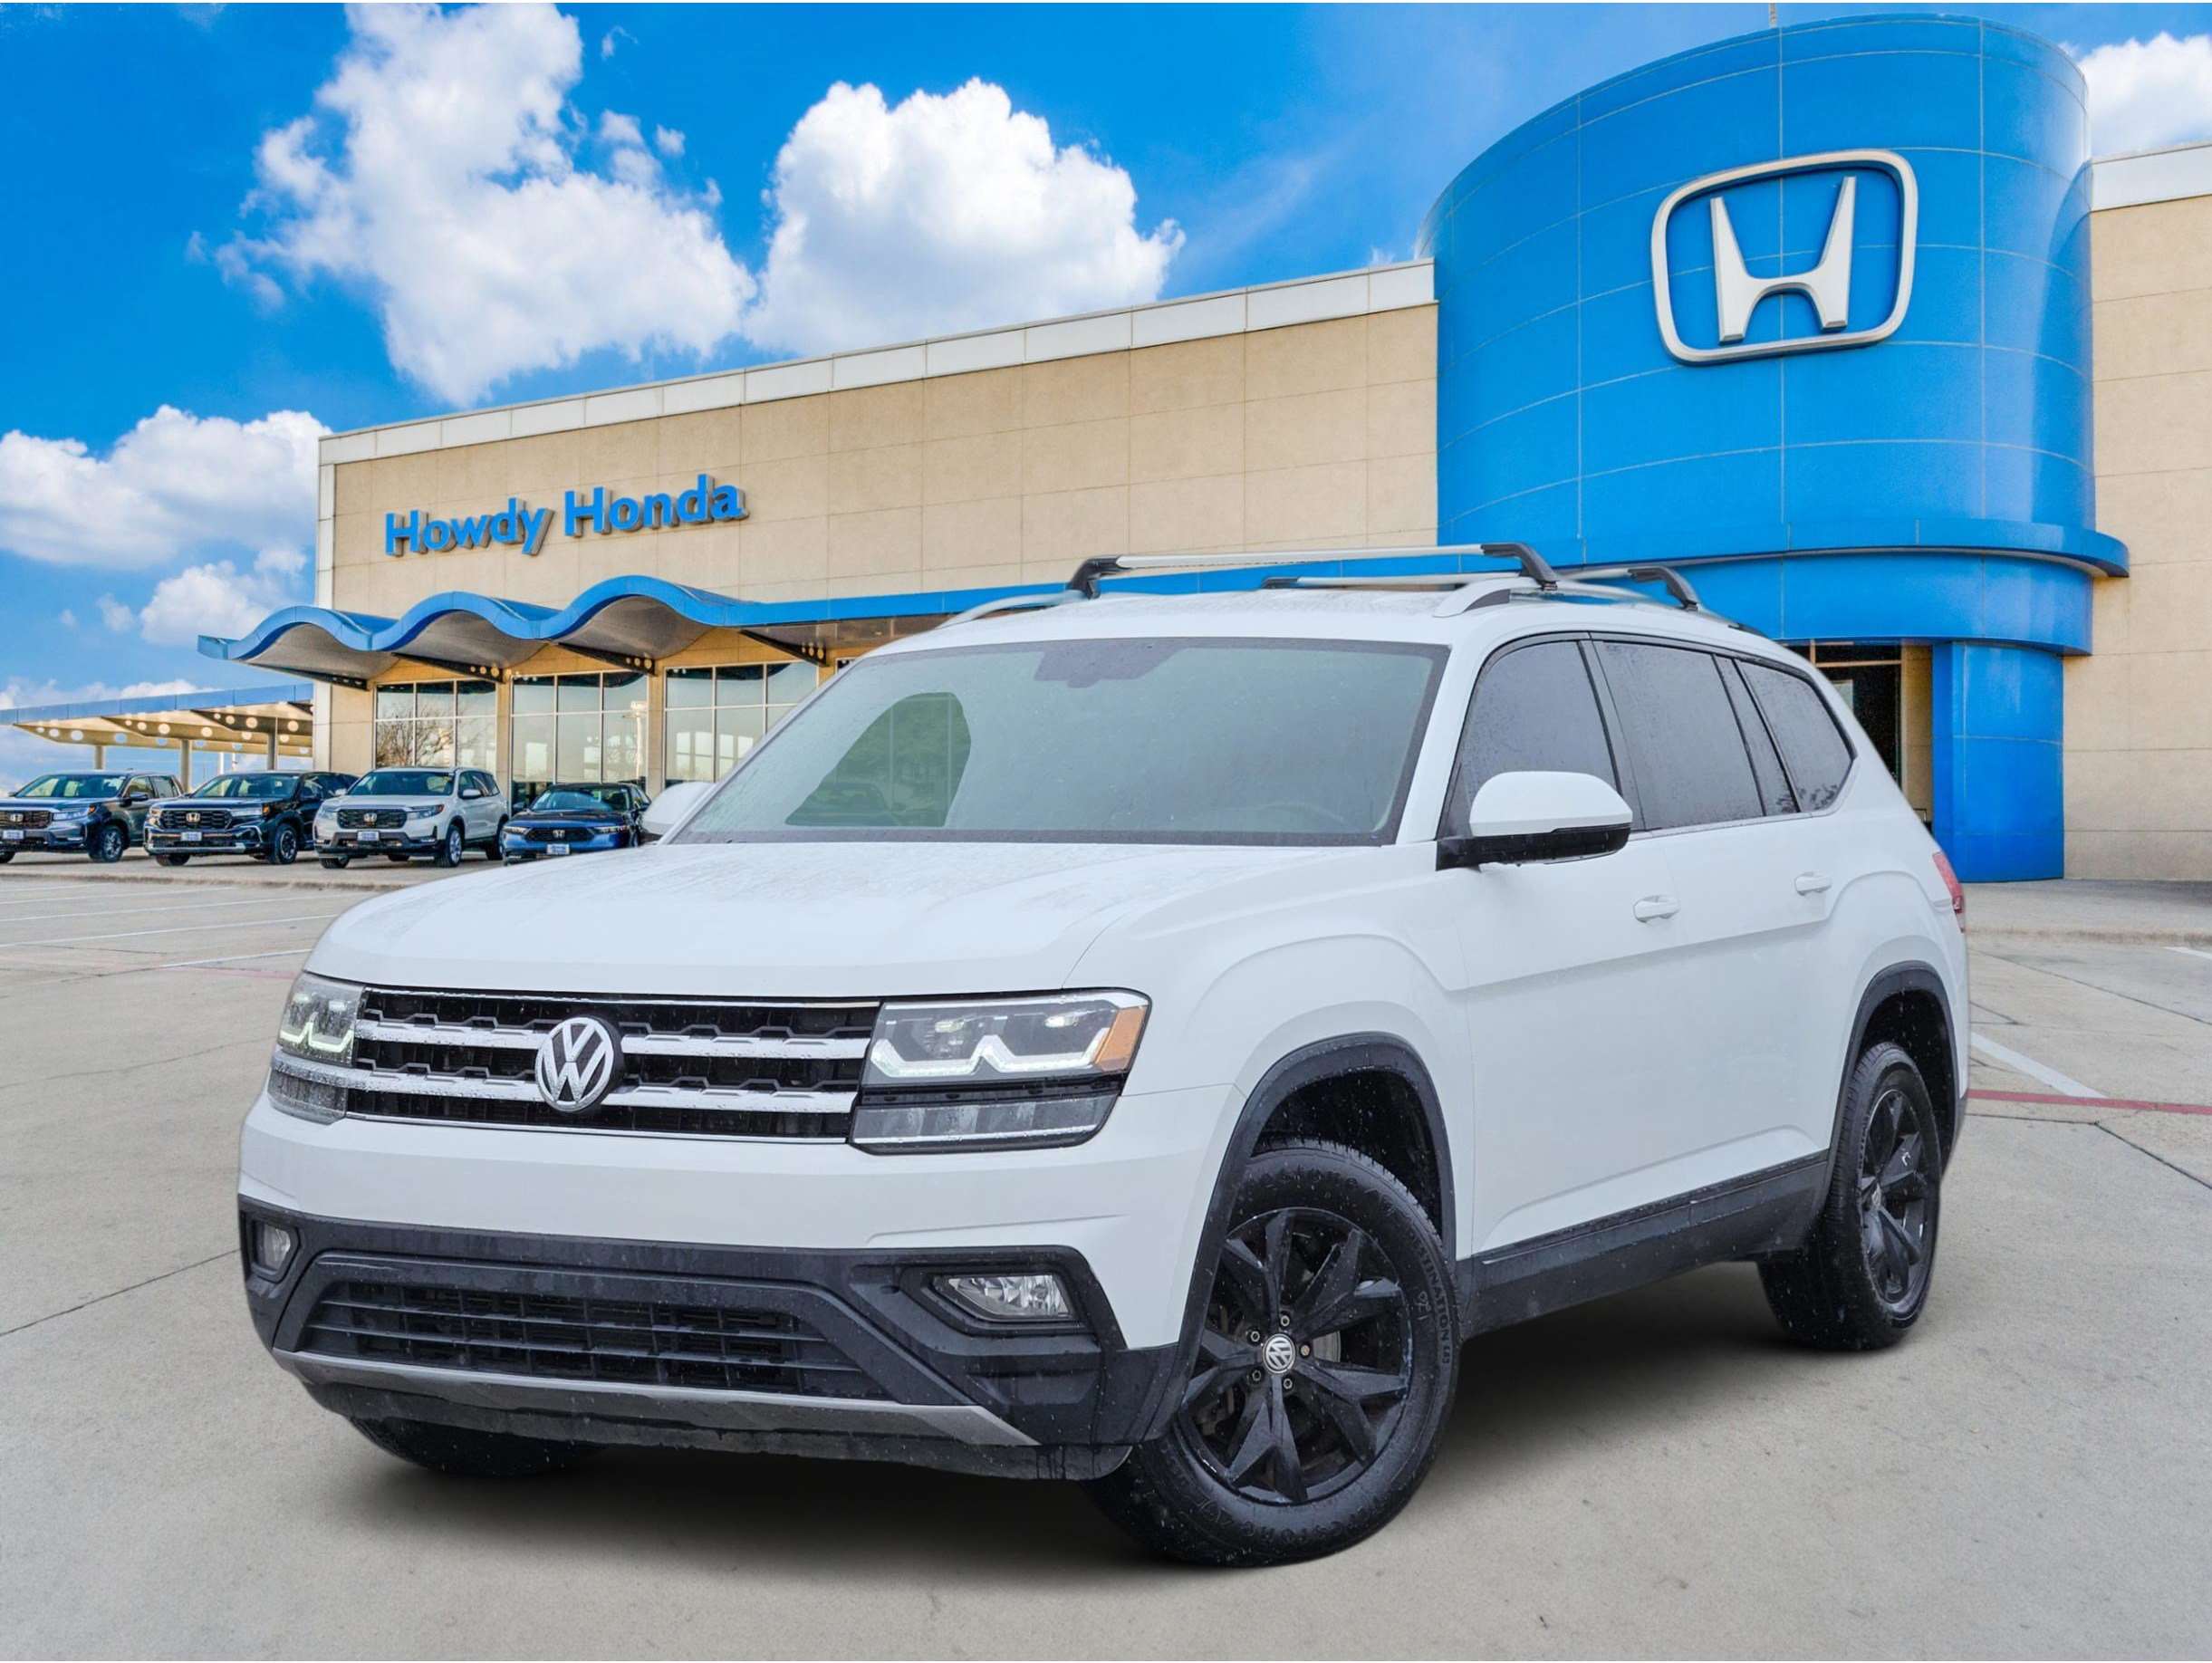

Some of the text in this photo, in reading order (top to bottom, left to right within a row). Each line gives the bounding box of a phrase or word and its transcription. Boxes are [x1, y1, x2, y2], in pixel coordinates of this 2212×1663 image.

[385, 473, 749, 557] Howdy Honda
[535, 1016, 614, 1112] VW
